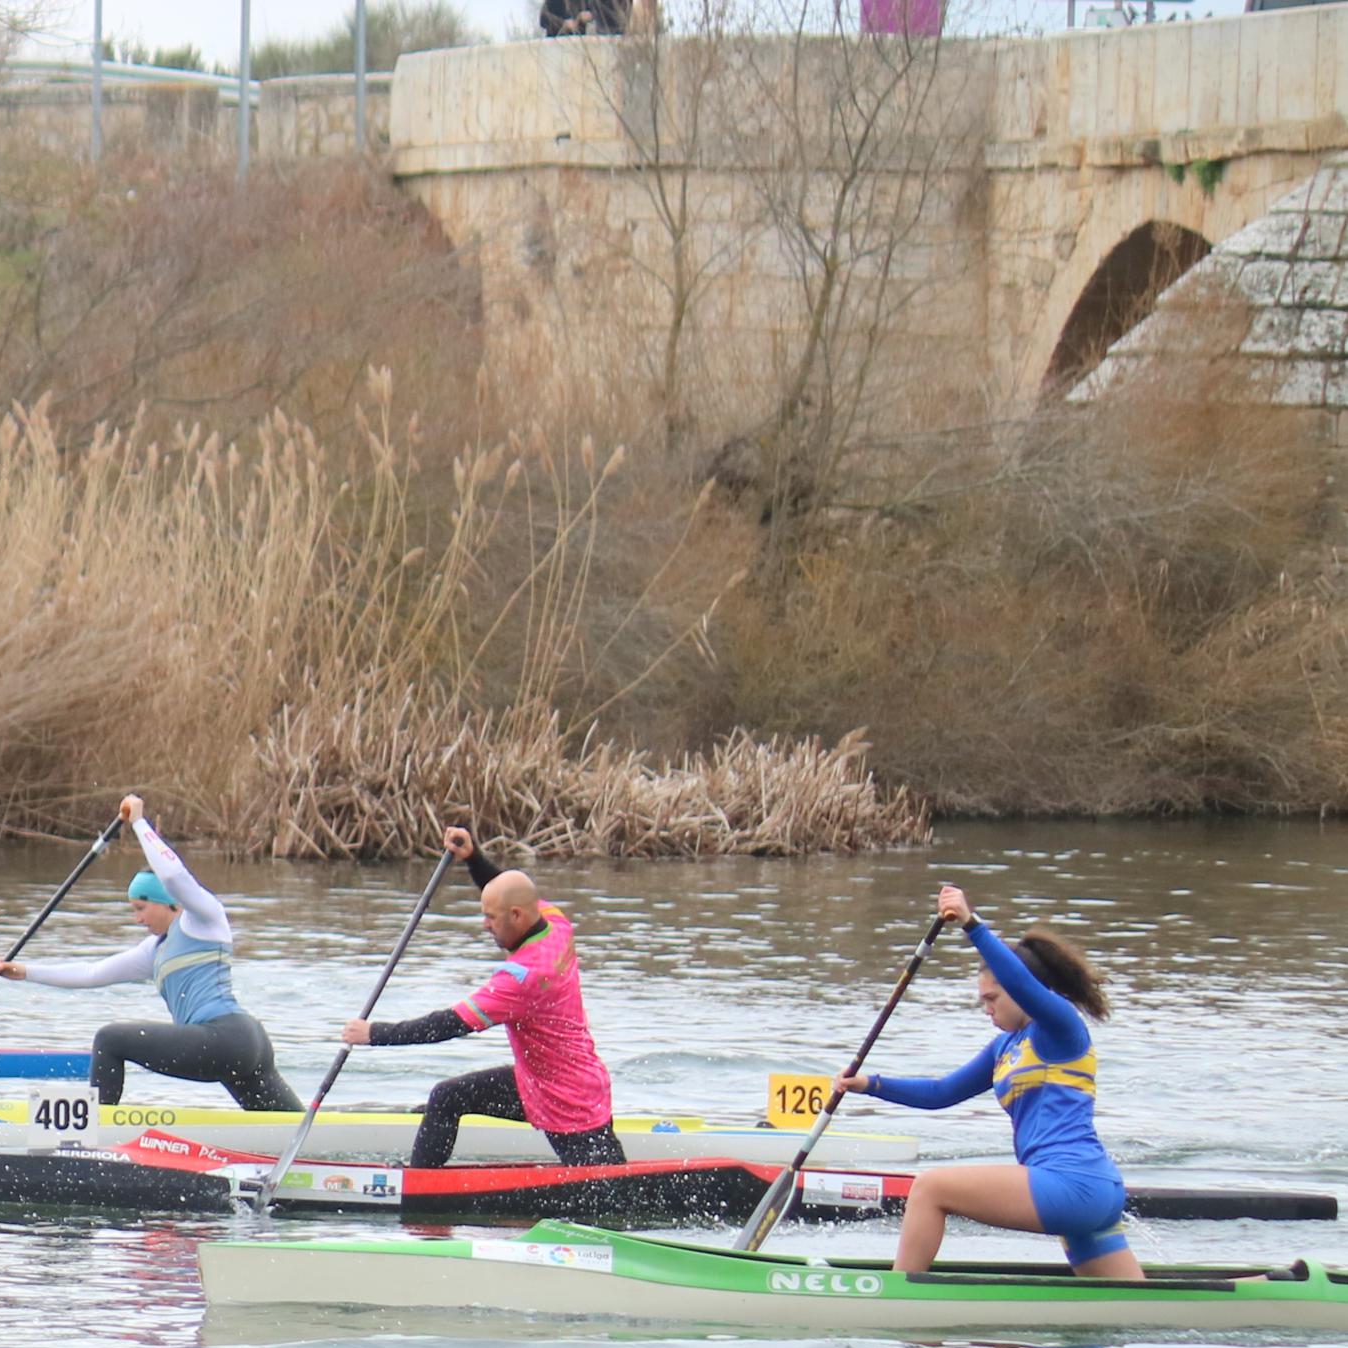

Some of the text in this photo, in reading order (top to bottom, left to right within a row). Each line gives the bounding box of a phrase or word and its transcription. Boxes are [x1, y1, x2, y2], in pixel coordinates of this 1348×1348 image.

[776, 1084, 823, 1116] 126
[34, 1098, 90, 1131] 409
[112, 1110, 176, 1127] COCO
[139, 1136, 190, 1155] WINNER
[770, 1271, 880, 1293] NELO
